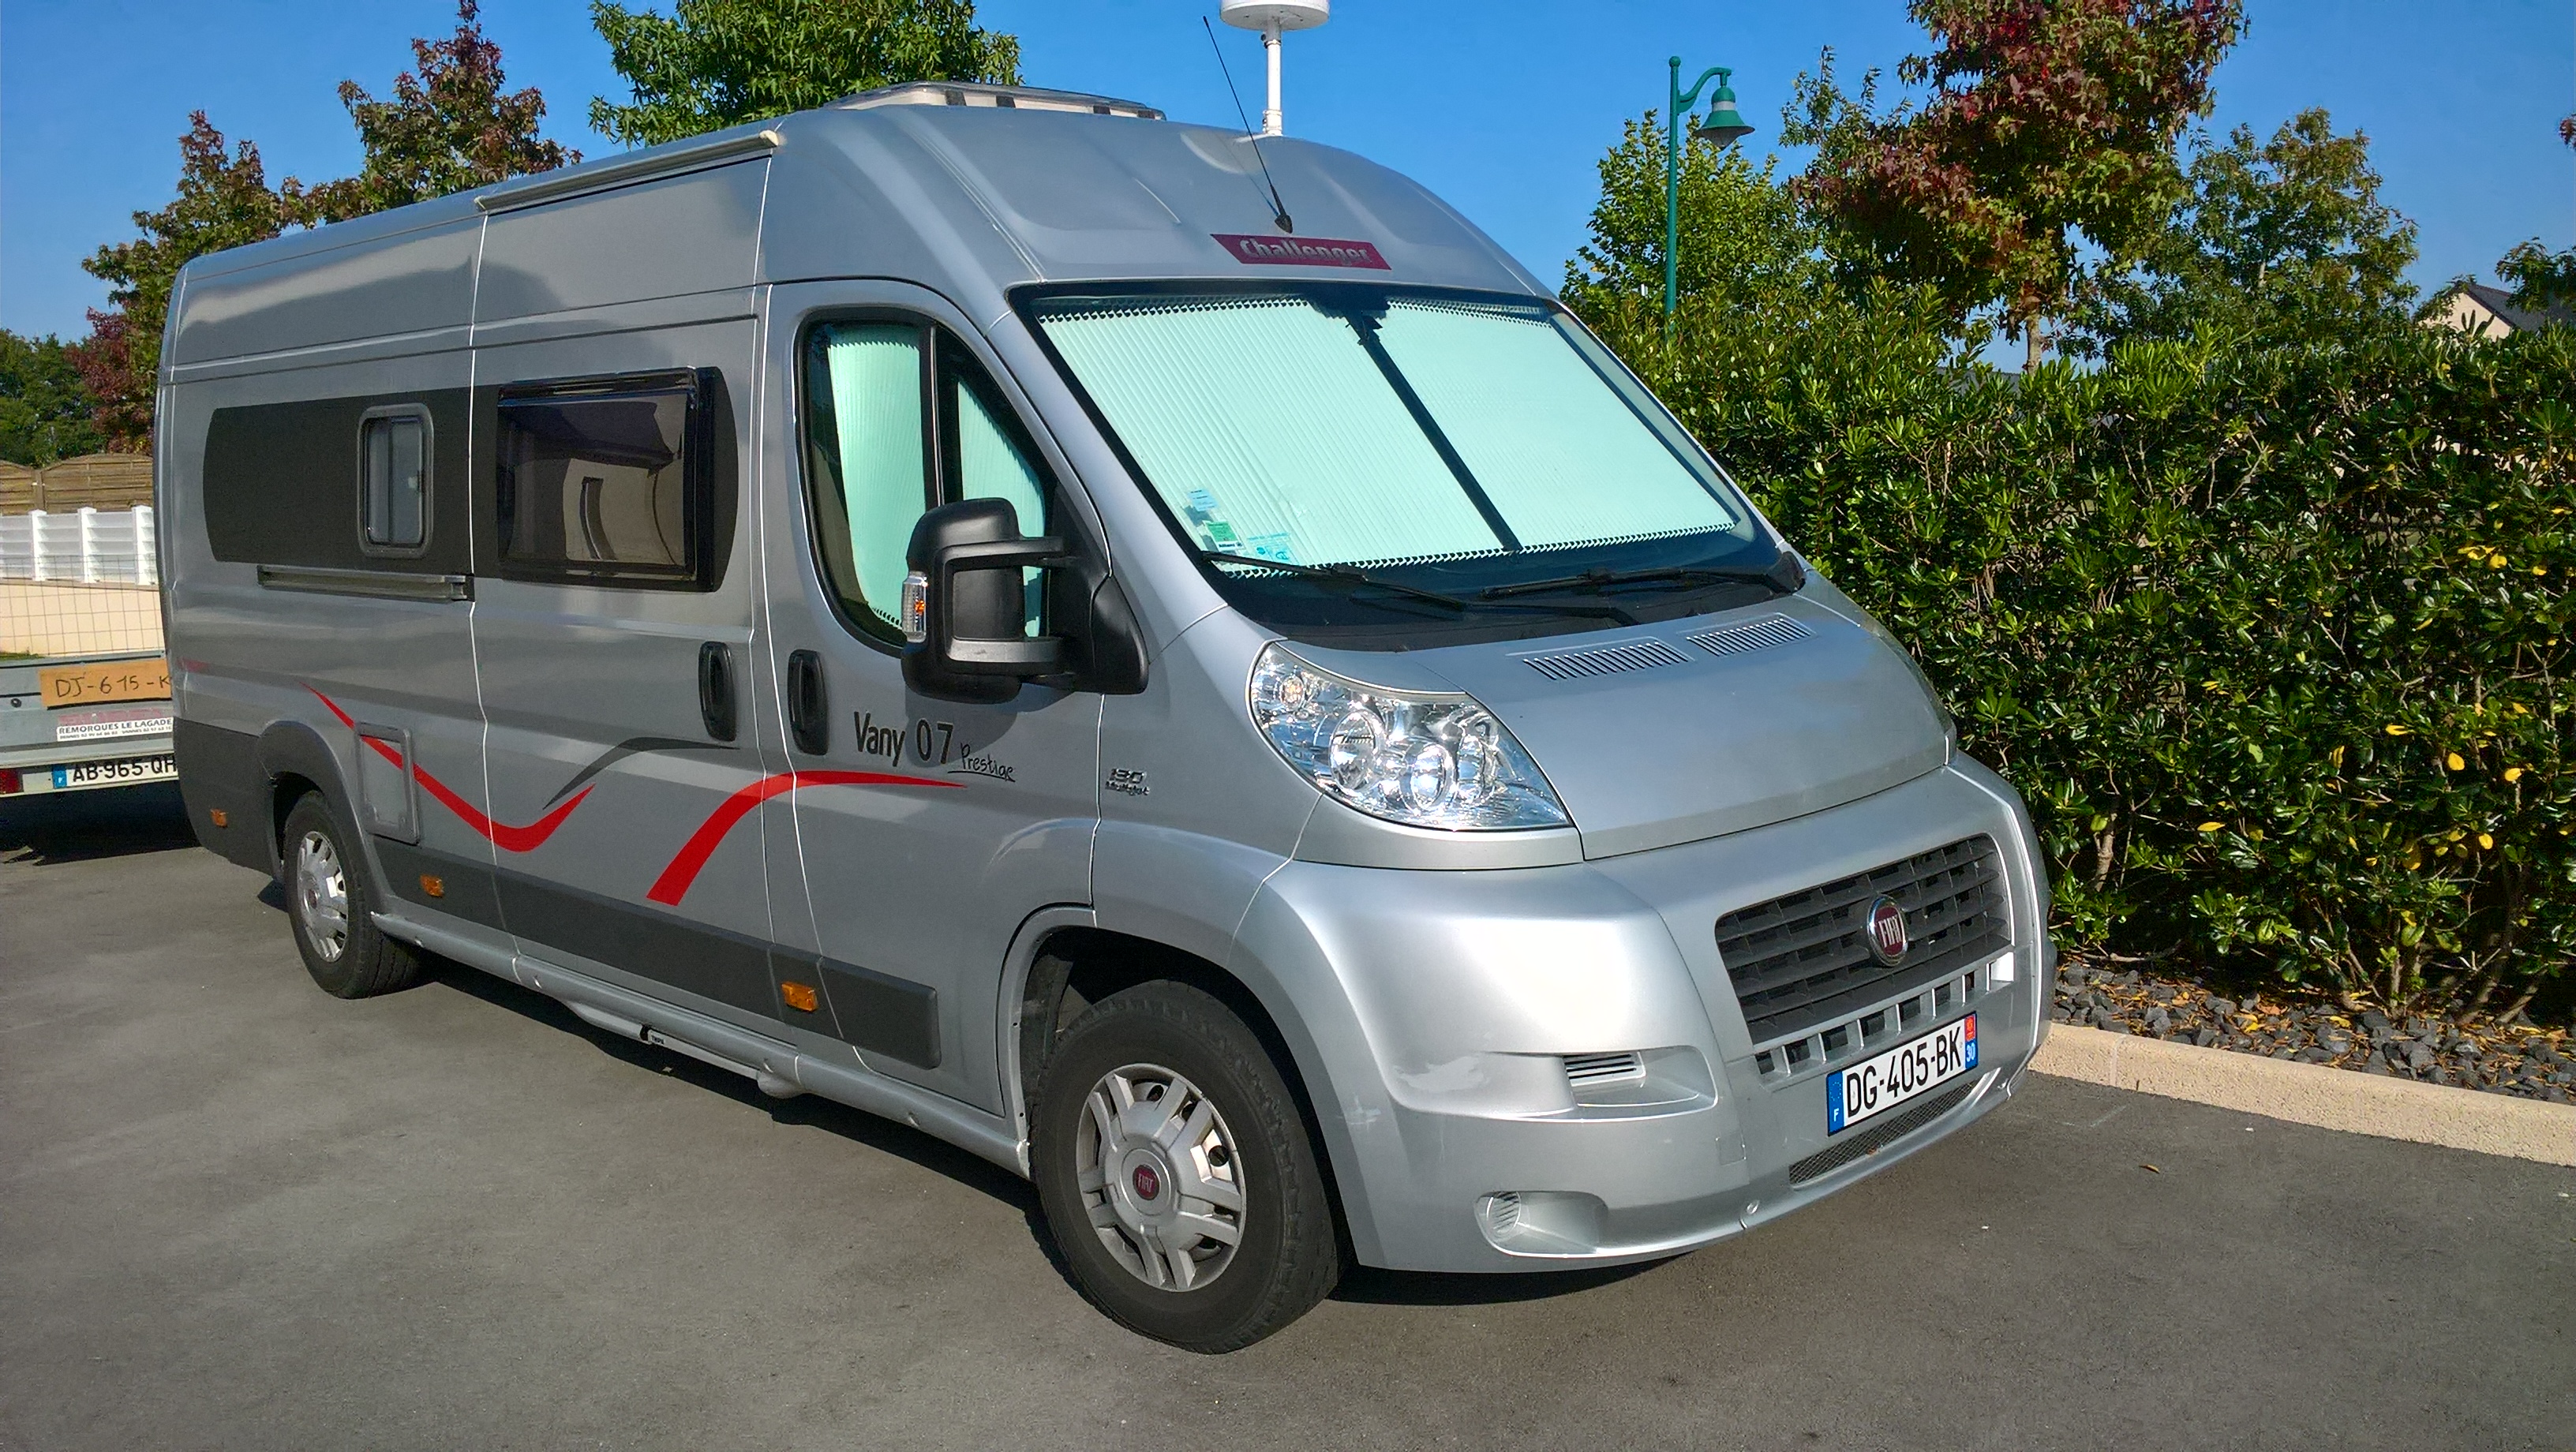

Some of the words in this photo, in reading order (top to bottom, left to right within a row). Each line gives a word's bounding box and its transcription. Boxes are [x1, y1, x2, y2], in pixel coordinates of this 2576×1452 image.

[1239, 239, 1372, 267] Challenger
[59, 723, 119, 734] REMORQUES
[134, 718, 172, 728] LAGADE
[854, 711, 905, 767] Vany
[915, 719, 954, 765] 07
[960, 742, 1015, 782] Prestige
[73, 754, 177, 782] AB-965-QH
[1109, 768, 1144, 784] 130
[1878, 915, 1903, 948] FIAT
[1966, 1042, 1976, 1063] 30
[1847, 1026, 1962, 1118] DG-405-BK
[1833, 1108, 1840, 1122] F
[1138, 1173, 1154, 1193] FIAT
